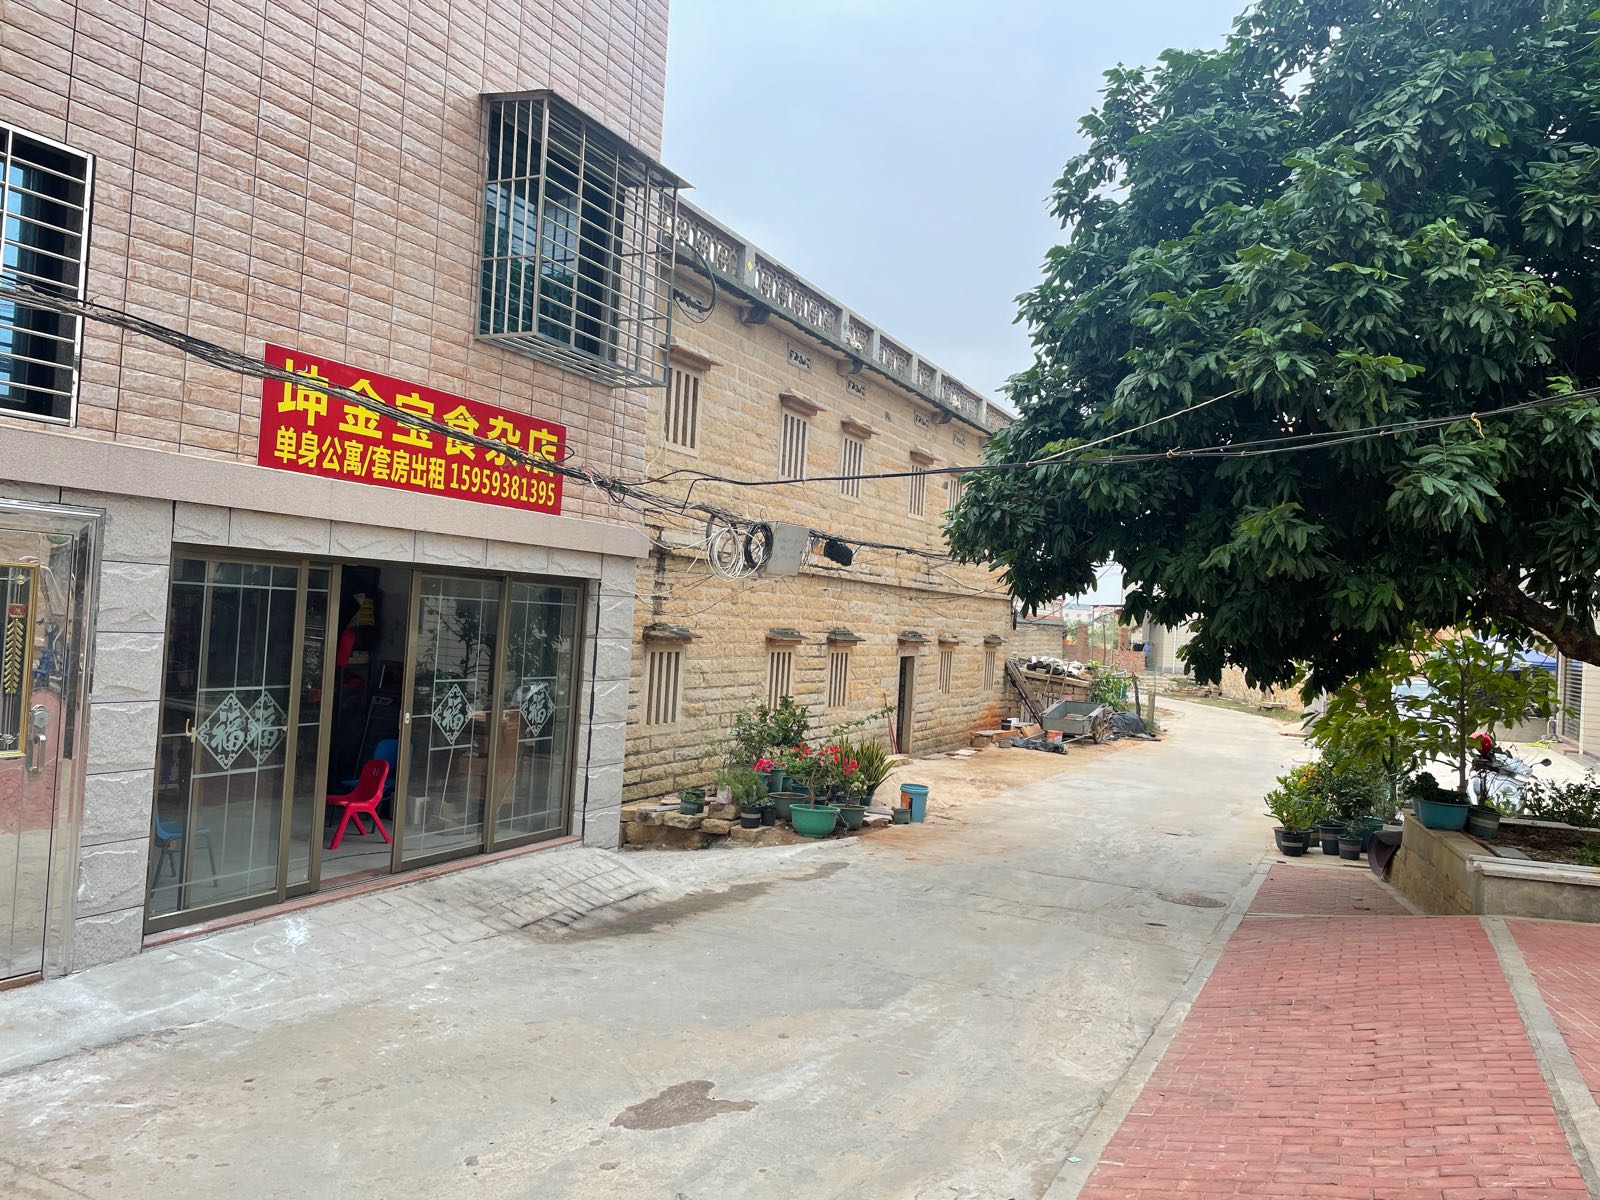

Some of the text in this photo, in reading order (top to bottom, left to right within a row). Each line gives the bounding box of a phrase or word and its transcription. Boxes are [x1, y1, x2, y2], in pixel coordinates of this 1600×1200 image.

[277, 358, 558, 477] 坤金宝食杂店
[274, 425, 555, 506] 单身公寓/套房出租 15959381395
[441, 696, 465, 730] 福
[528, 692, 547, 724] 福
[211, 709, 245, 752] 福
